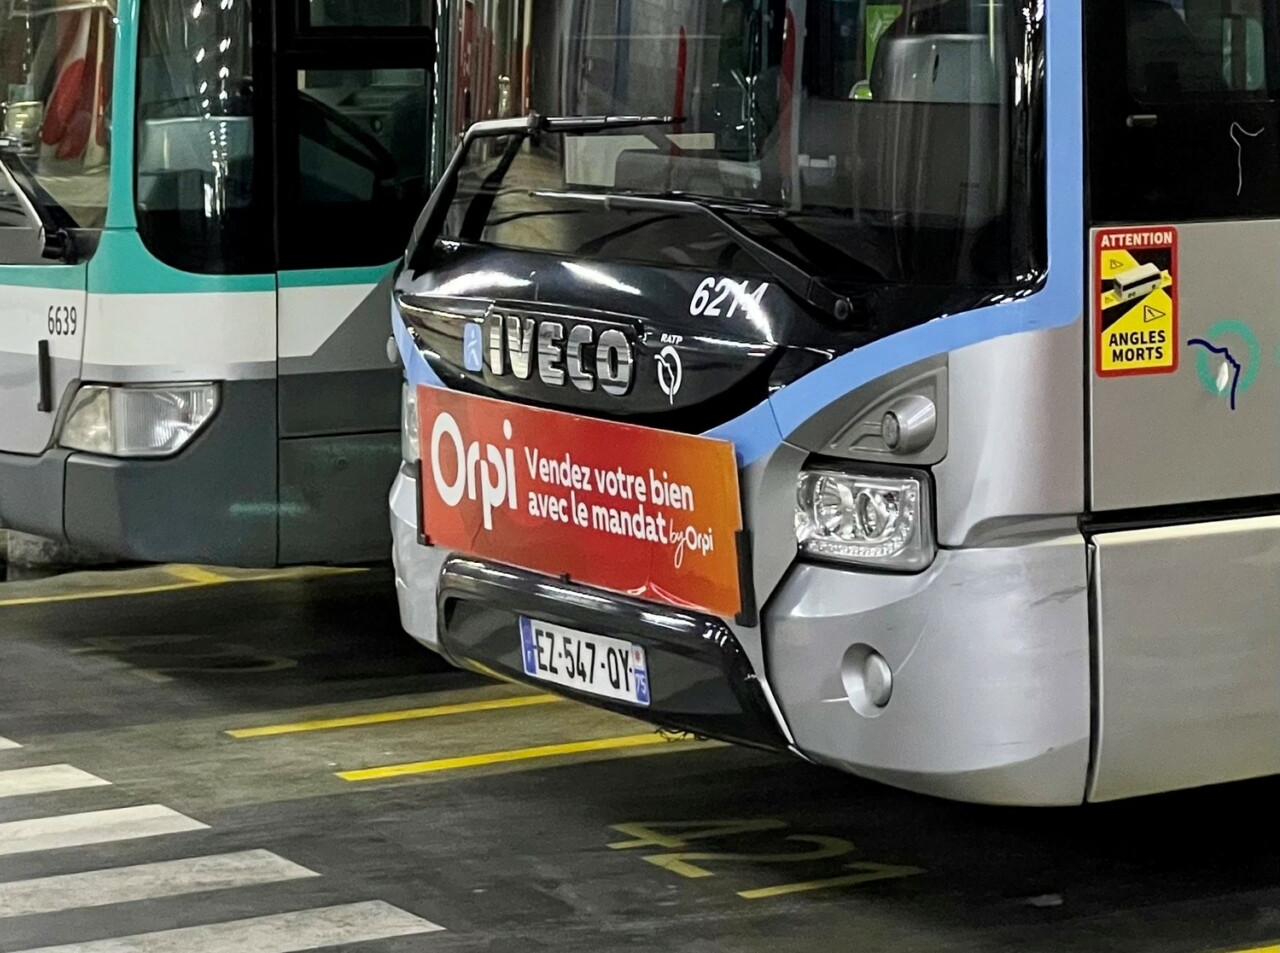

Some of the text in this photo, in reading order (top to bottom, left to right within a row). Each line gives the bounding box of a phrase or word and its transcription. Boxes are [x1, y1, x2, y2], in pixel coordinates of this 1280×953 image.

[1101, 231, 1173, 247] ATTENTION
[689, 276, 770, 320] 6214
[48, 306, 77, 336] 6639
[660, 333, 684, 345] RATP
[1109, 330, 1166, 347] ANGLES
[488, 313, 634, 396] IVECO
[1112, 347, 1164, 363] MORTS
[431, 412, 517, 530] Orpi
[524, 446, 694, 511] Vendez votre bien
[528, 490, 569, 523] avec
[571, 490, 589, 527] le
[592, 504, 668, 544] mandat
[535, 628, 630, 692] EZ-547-QY
[636, 672, 647, 695] 75
[606, 819, 927, 899] 421
